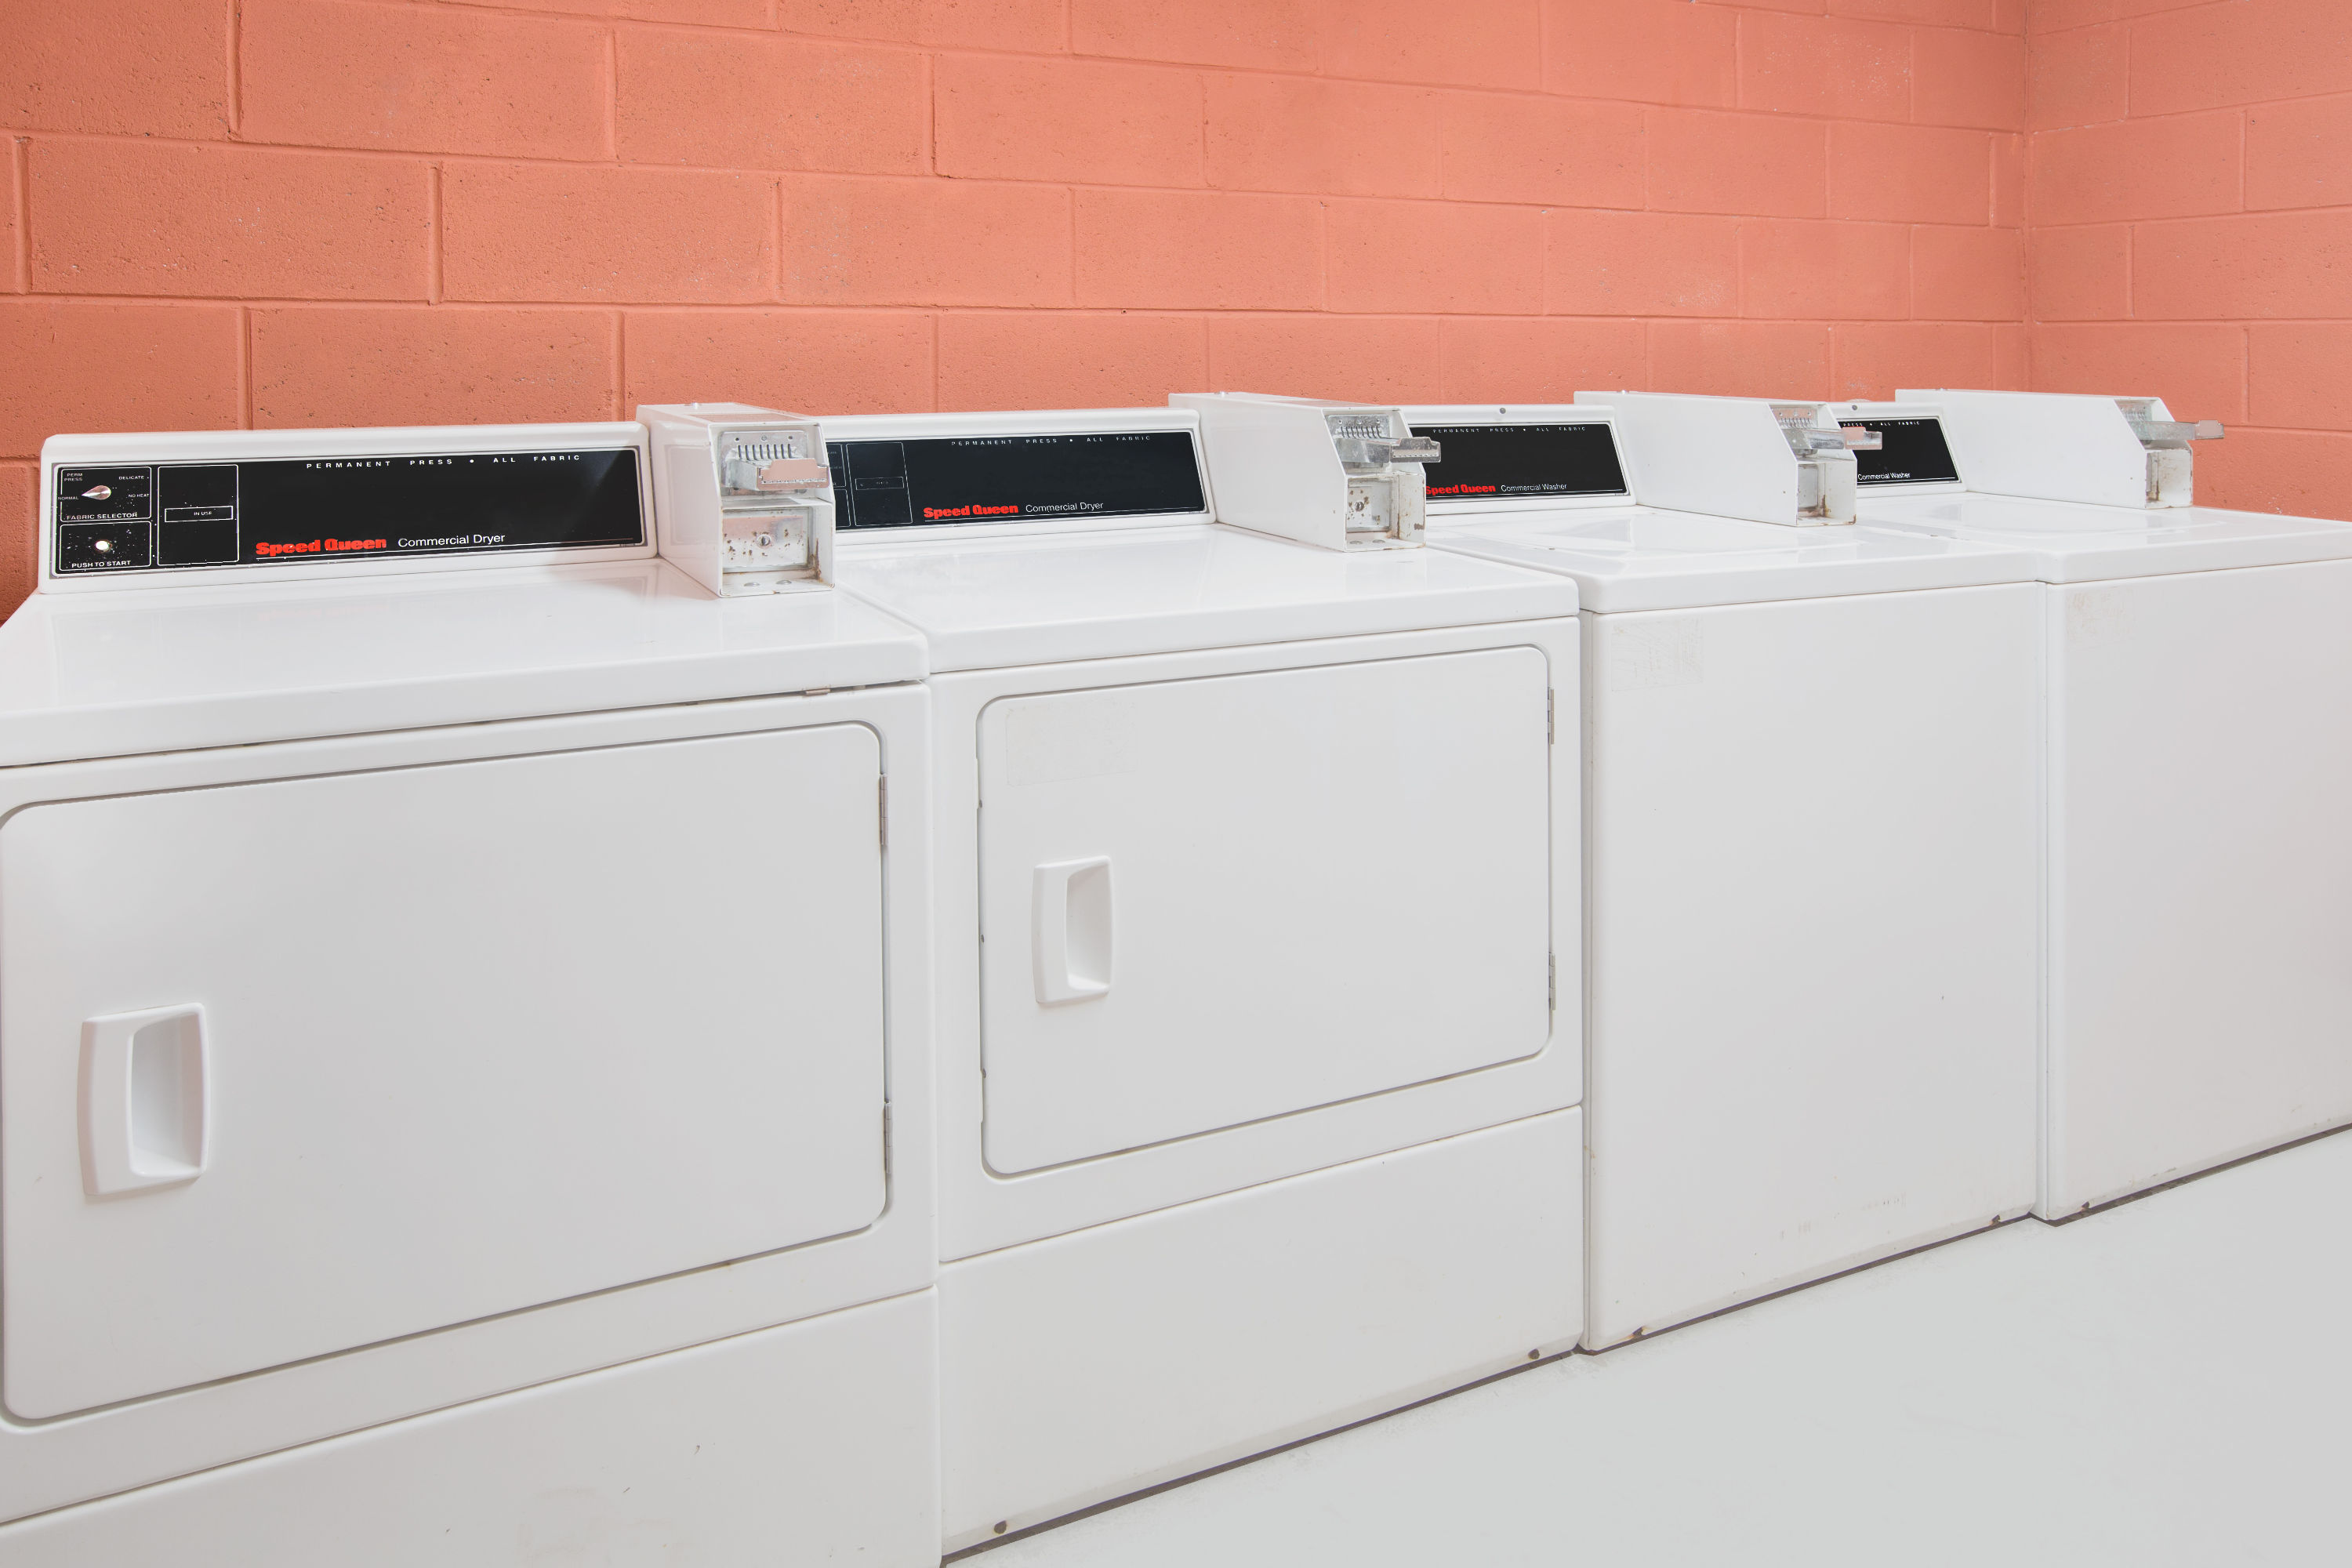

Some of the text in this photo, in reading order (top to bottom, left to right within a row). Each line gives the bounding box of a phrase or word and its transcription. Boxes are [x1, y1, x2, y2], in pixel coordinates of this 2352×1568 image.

[307, 460, 390, 469] PERMANENT
[1425, 485, 1460, 496] Speed
[1460, 484, 1496, 493] Queen
[1501, 484, 1541, 492] Commercial
[924, 502, 1104, 520] Speed Queen Commercial Dryer
[256, 534, 506, 557] Speed Queen Commercial Dryer
